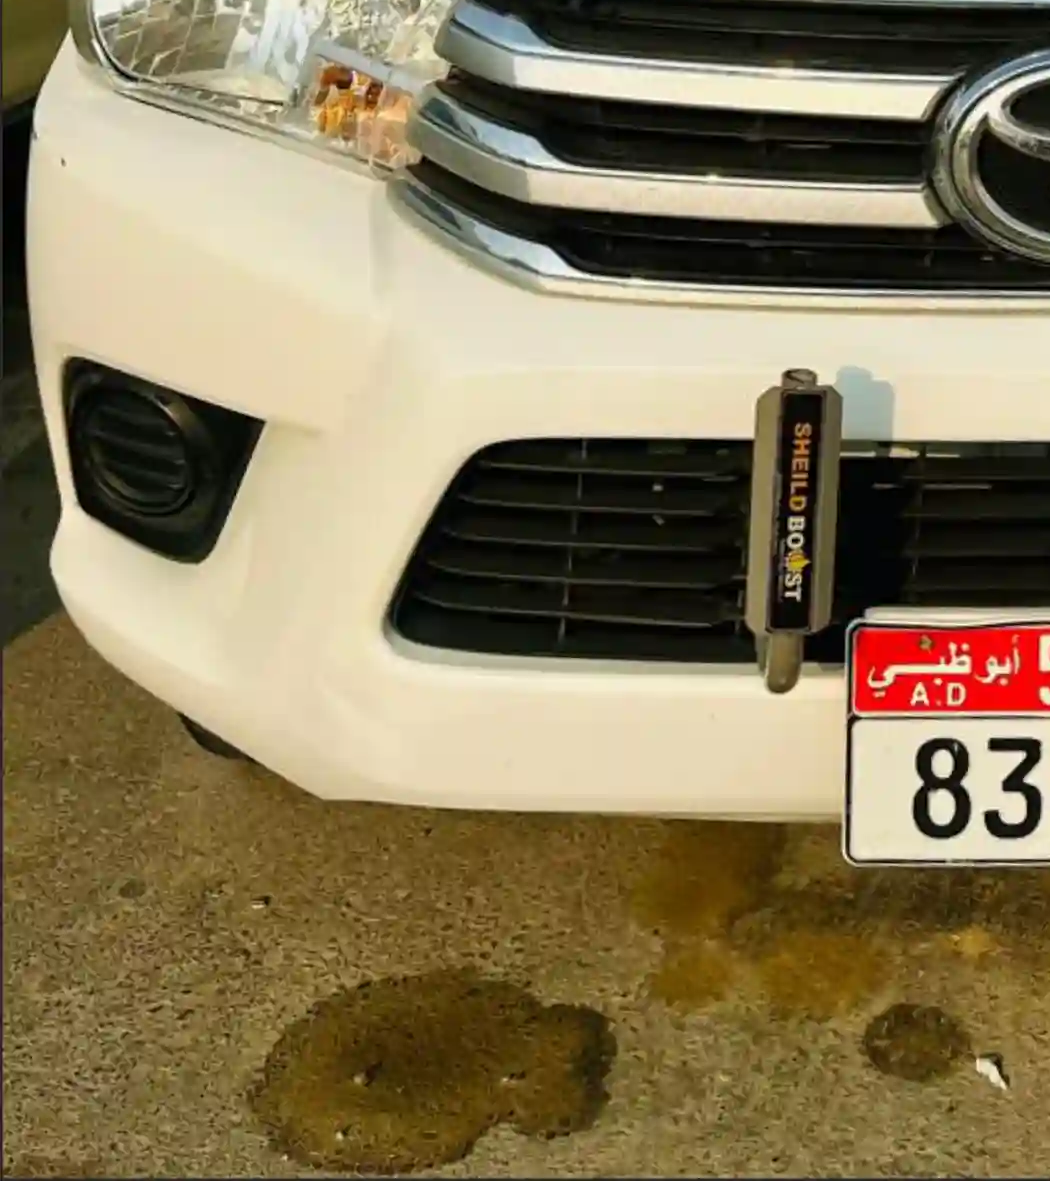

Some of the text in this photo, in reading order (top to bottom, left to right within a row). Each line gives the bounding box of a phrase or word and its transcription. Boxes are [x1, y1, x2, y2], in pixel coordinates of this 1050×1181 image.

[788, 421, 813, 512] SHEILD
[867, 641, 972, 698] ظبي
[909, 681, 968, 707] A.D
